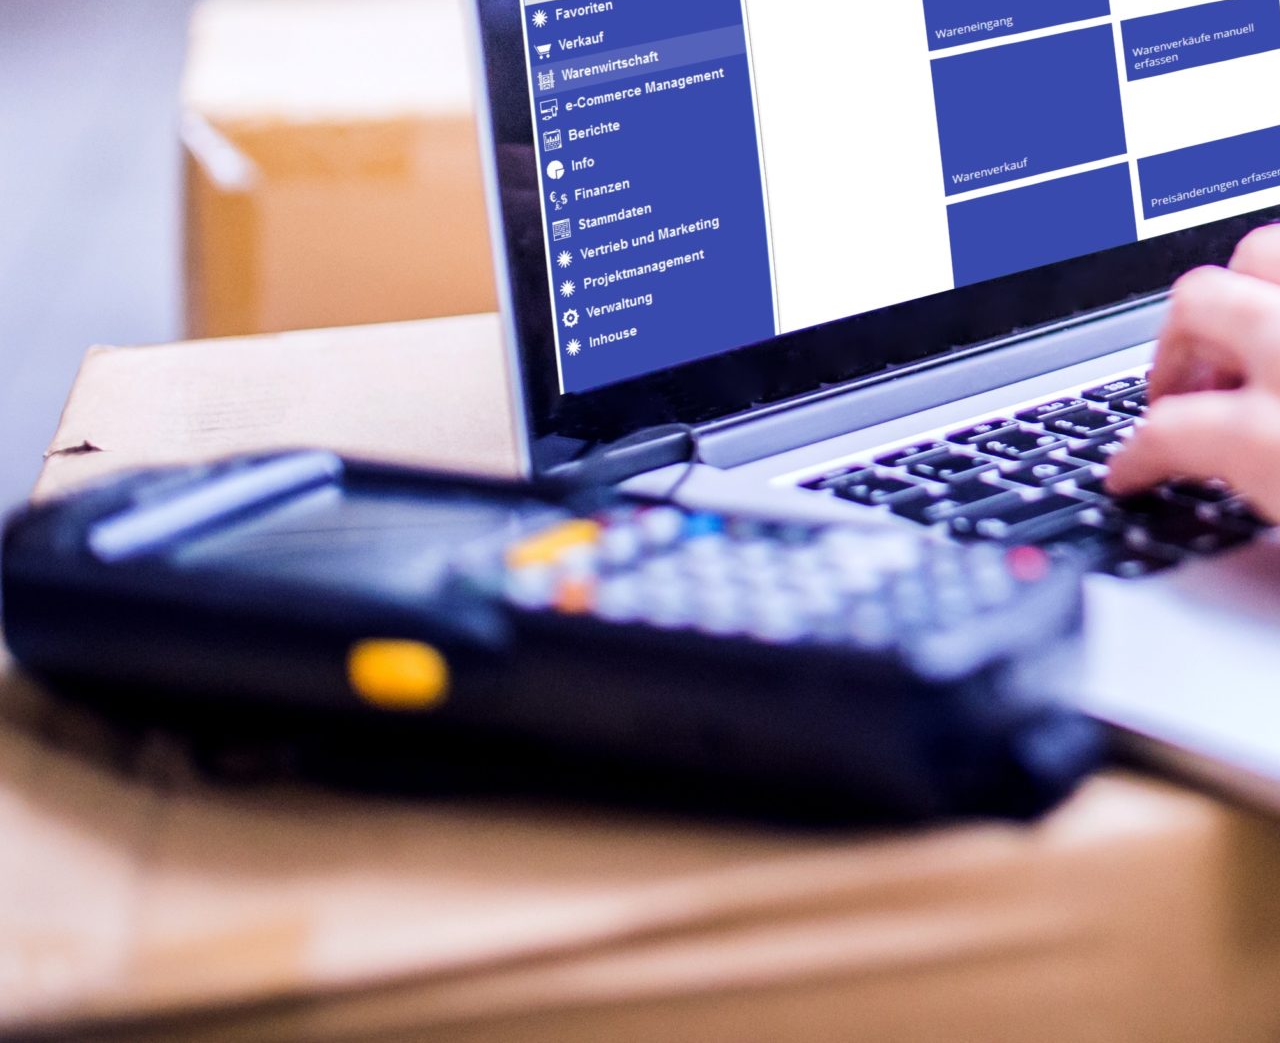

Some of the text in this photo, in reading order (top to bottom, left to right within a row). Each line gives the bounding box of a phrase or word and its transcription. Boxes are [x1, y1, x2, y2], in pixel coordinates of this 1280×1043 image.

[555, 1, 613, 20] Favoriten
[935, 17, 1014, 39] Wareneingang
[1132, 23, 1254, 57] Warenverkäufe manuell
[558, 31, 604, 50] Verkauf
[561, 51, 659, 81] Warenwirtschaft
[1134, 54, 1178, 70] erfassen
[565, 68, 724, 111] e-Commerce Management
[568, 122, 620, 141] Berichte
[571, 157, 595, 171] Info
[952, 158, 1027, 184] Warenverkauf
[575, 180, 630, 201] Finanzen
[1151, 180, 1239, 207] Preisänderungen
[578, 205, 652, 230] Stammdaten
[580, 218, 719, 259] Vertrieb und Marketing
[584, 250, 705, 289] Projektmanagement
[586, 294, 653, 318] Verwaltung
[589, 327, 637, 348] Inhouse
